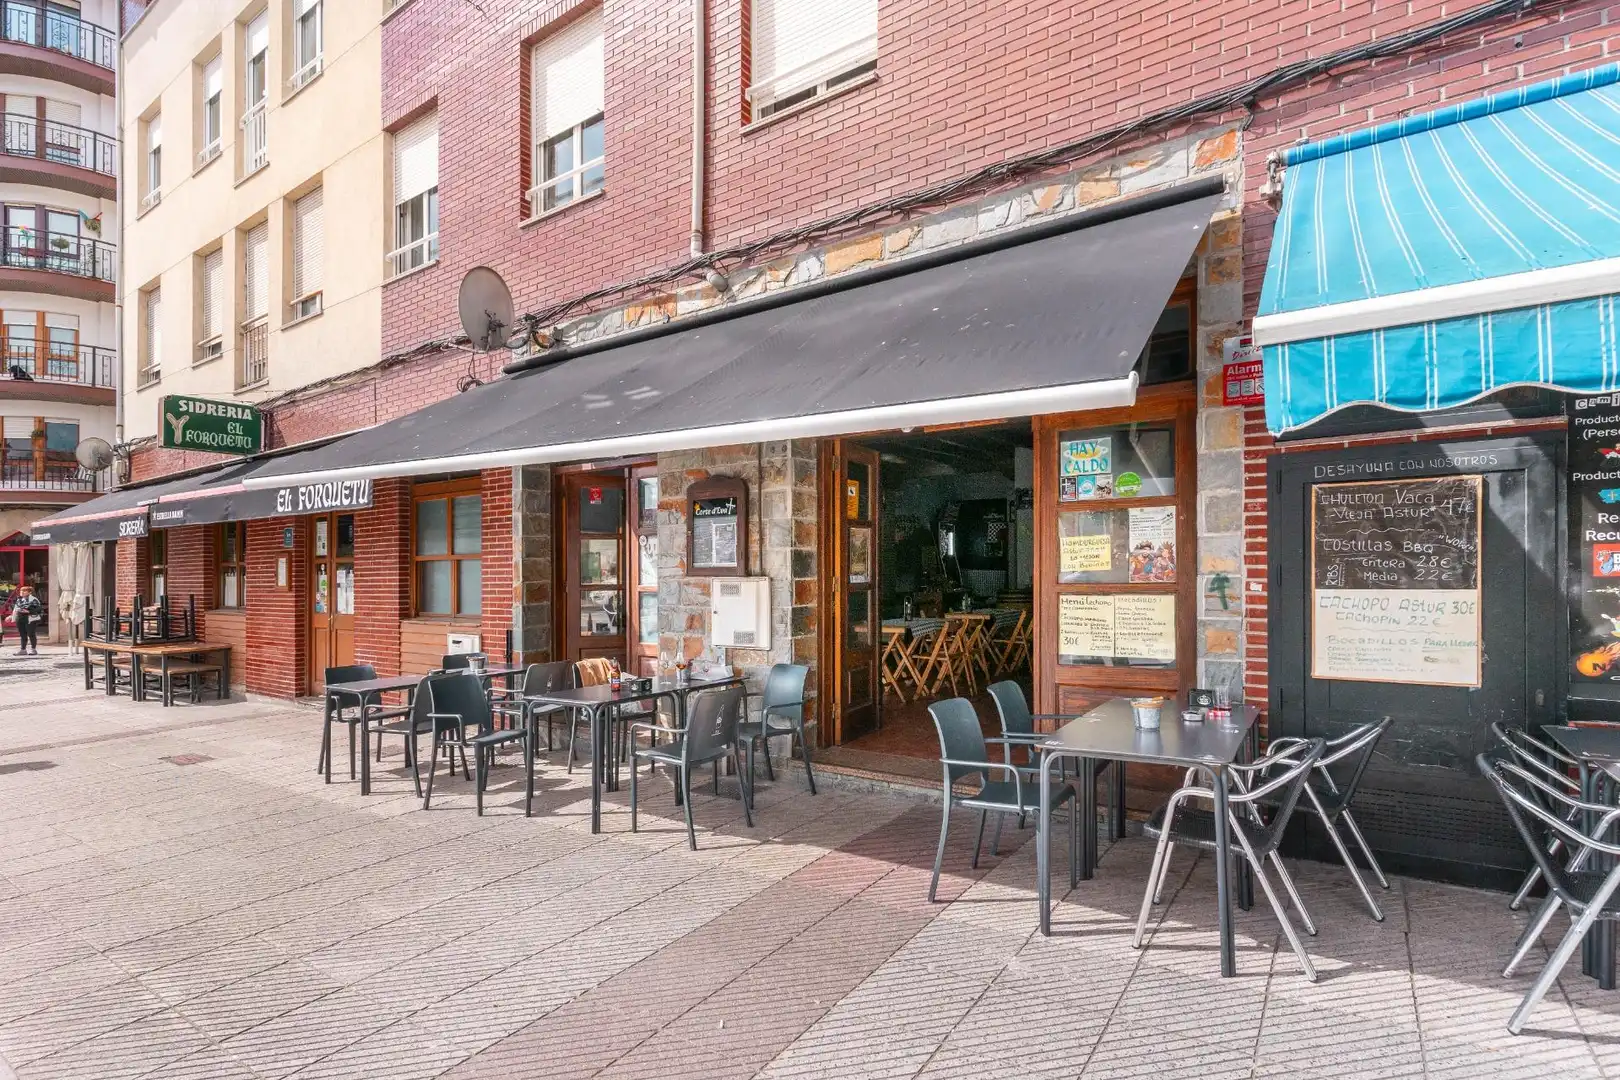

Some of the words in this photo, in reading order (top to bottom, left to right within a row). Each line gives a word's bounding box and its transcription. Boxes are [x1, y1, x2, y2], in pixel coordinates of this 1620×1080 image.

[178, 399, 253, 421] SIDRERIA
[227, 421, 244, 435] EL
[185, 429, 253, 449] FORQUETU
[1069, 440, 1099, 456] HAY
[1064, 457, 1109, 474] CALDO
[1314, 461, 1395, 479] DESAYUNA
[1399, 459, 1425, 471] CON
[1430, 454, 1498, 468] NOSOTROS
[277, 488, 292, 512] EL
[298, 479, 370, 511] FORQUETU
[1320, 492, 1384, 505] CHULETON
[1396, 489, 1434, 504] Vaca
[1403, 540, 1434, 553] BBQ
[1416, 555, 1452, 568] 28€
[1325, 564, 1339, 586] RIBS
[1363, 570, 1398, 581] Media
[1414, 569, 1453, 581] 22€
[1319, 595, 1390, 611] CACHOPO
[1451, 600, 1475, 615] 30€
